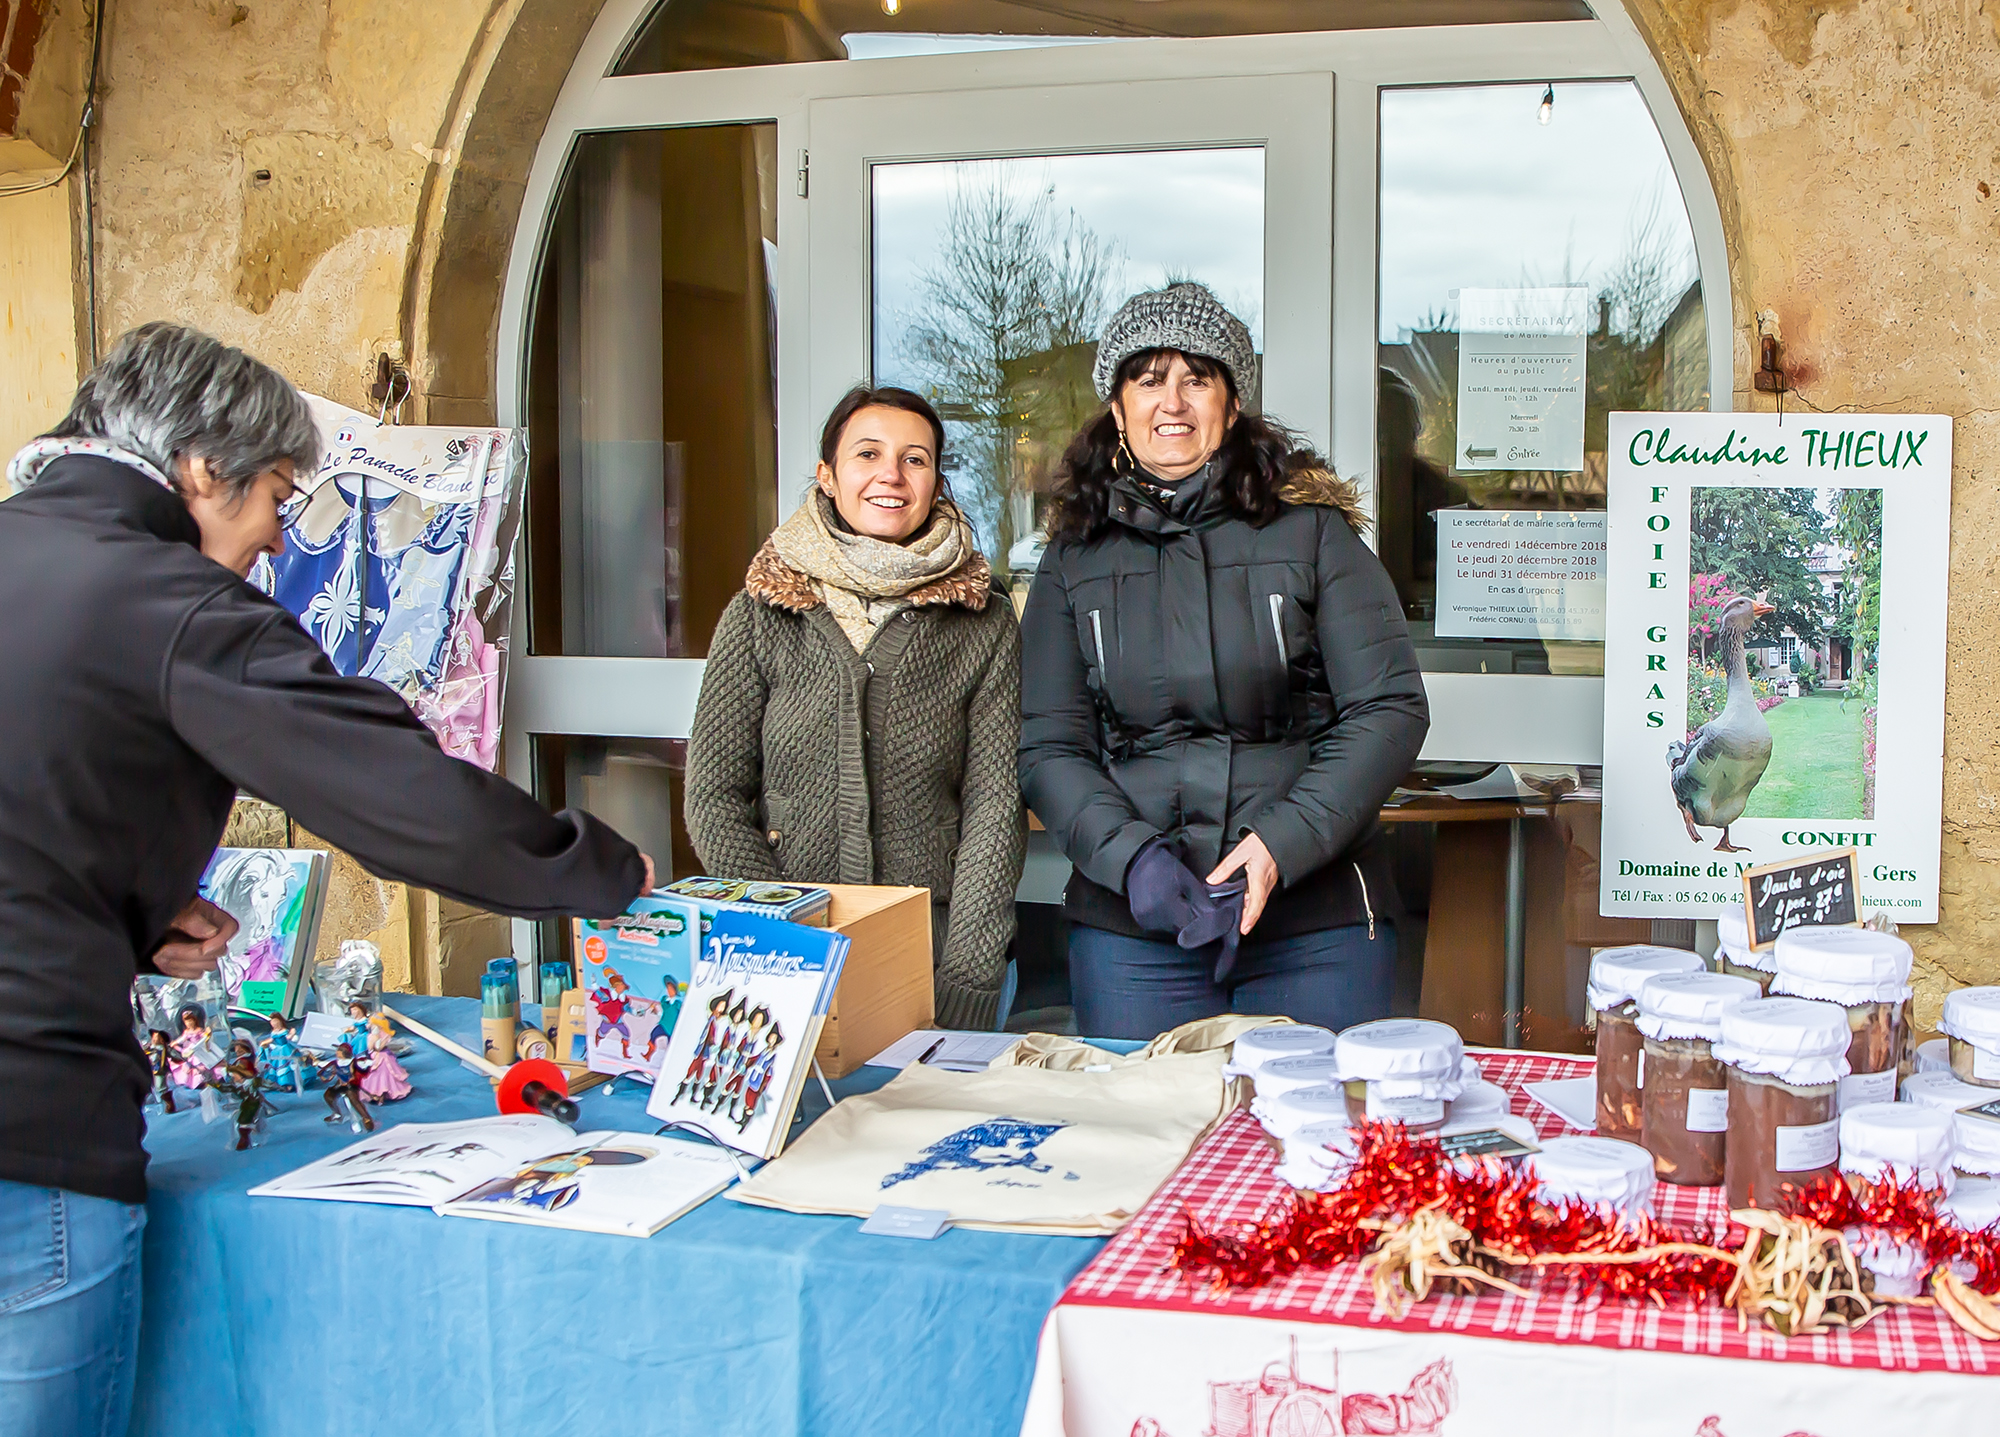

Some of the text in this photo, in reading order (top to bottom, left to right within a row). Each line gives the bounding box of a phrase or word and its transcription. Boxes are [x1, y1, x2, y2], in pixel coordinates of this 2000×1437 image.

[1479, 314, 1573, 326] SECRÉTARIAT
[1510, 356, 1573, 364] d'ouverture
[1514, 367, 1545, 376] public
[1467, 385, 1491, 393] Lundi,
[1493, 385, 1518, 393] mardi,
[1519, 385, 1541, 393] jeudi,
[1507, 445, 1541, 461] Entrée
[1628, 427, 1928, 471] Claudine THIEUX
[318, 452, 342, 473] Le
[348, 447, 420, 485] Panache
[423, 472, 475, 493] Blanc
[1452, 519, 1463, 527] Le
[1465, 518, 1510, 527] secrétariat
[1513, 519, 1524, 527] de
[1527, 520, 1553, 528] mairie
[1577, 520, 1603, 528] fermé
[1451, 539, 1607, 551] Le vendredi 14décembre 2018
[1457, 554, 1597, 566] Le jeudi 20 décembre 2018
[1457, 569, 1597, 580] Le lundi 31 décembre 2018
[1452, 605, 1487, 613] Véronique
[1645, 486, 1671, 729] FOIE GRAS
[1468, 615, 1497, 623] Frédéric
[1781, 831, 1877, 847] CONFIT
[1618, 859, 1701, 877] Domaine
[1706, 861, 1728, 878] de
[1872, 864, 1917, 882] Gers
[1611, 889, 1631, 902] Tél
[1634, 890, 1639, 902] /
[1643, 890, 1664, 903] Fax
[1675, 891, 1690, 903] 05
[1694, 891, 1709, 903] 62
[1712, 892, 1727, 904] 06
[1730, 892, 1744, 904] 42
[1861, 895, 1922, 908] hieux.com
[697, 936, 804, 987] Mousquetaires
